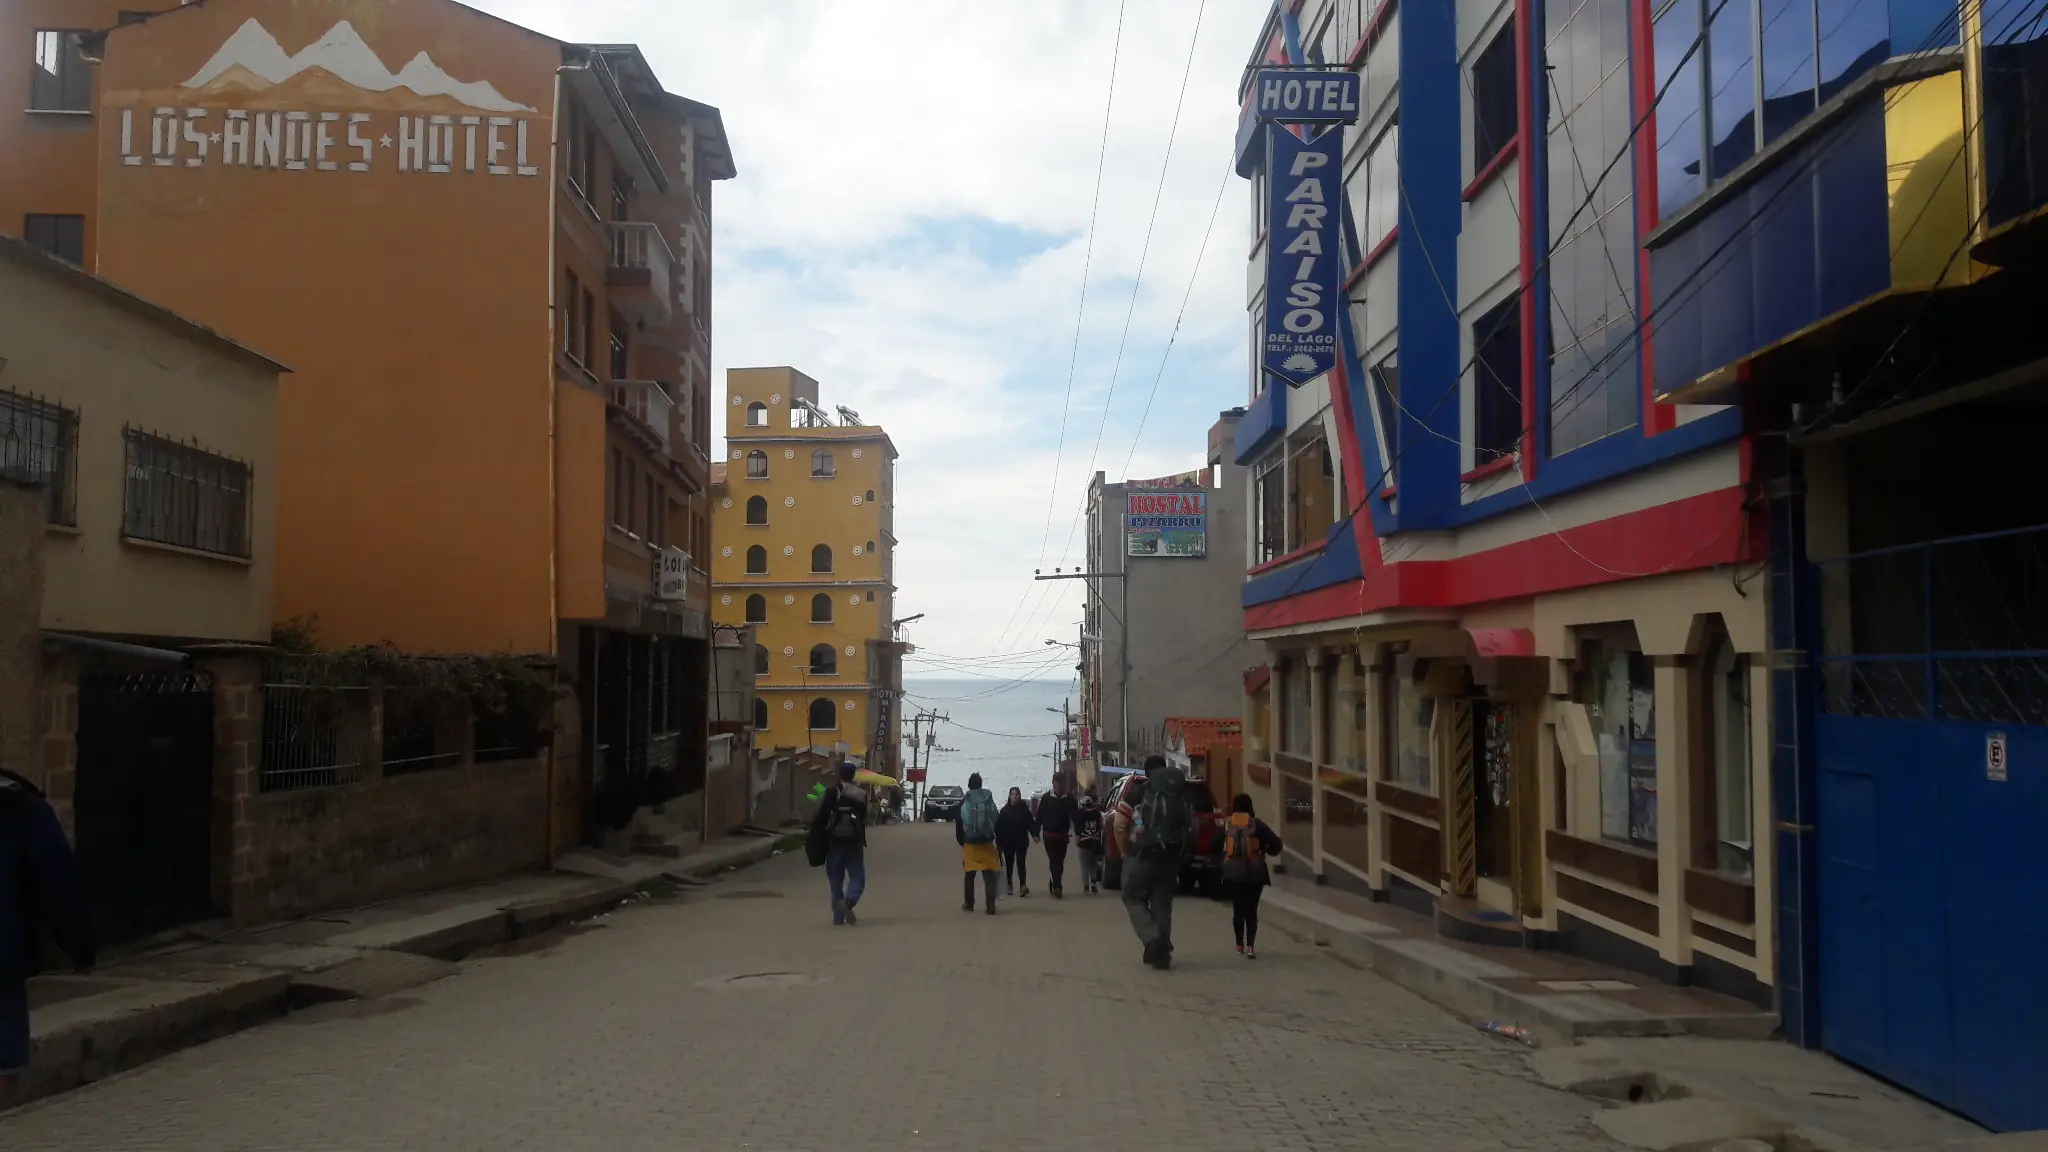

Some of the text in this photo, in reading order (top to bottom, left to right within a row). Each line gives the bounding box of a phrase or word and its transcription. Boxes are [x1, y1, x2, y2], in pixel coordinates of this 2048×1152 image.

[1262, 80, 1356, 111] HOTEL
[120, 107, 541, 176] LOS ANDES HOTEL
[1281, 151, 1329, 333] PARAISO
[1268, 333, 1334, 344] DEL LAGO
[1130, 495, 1204, 515] HOSTAL
[1132, 517, 1202, 527] PIZARRO
